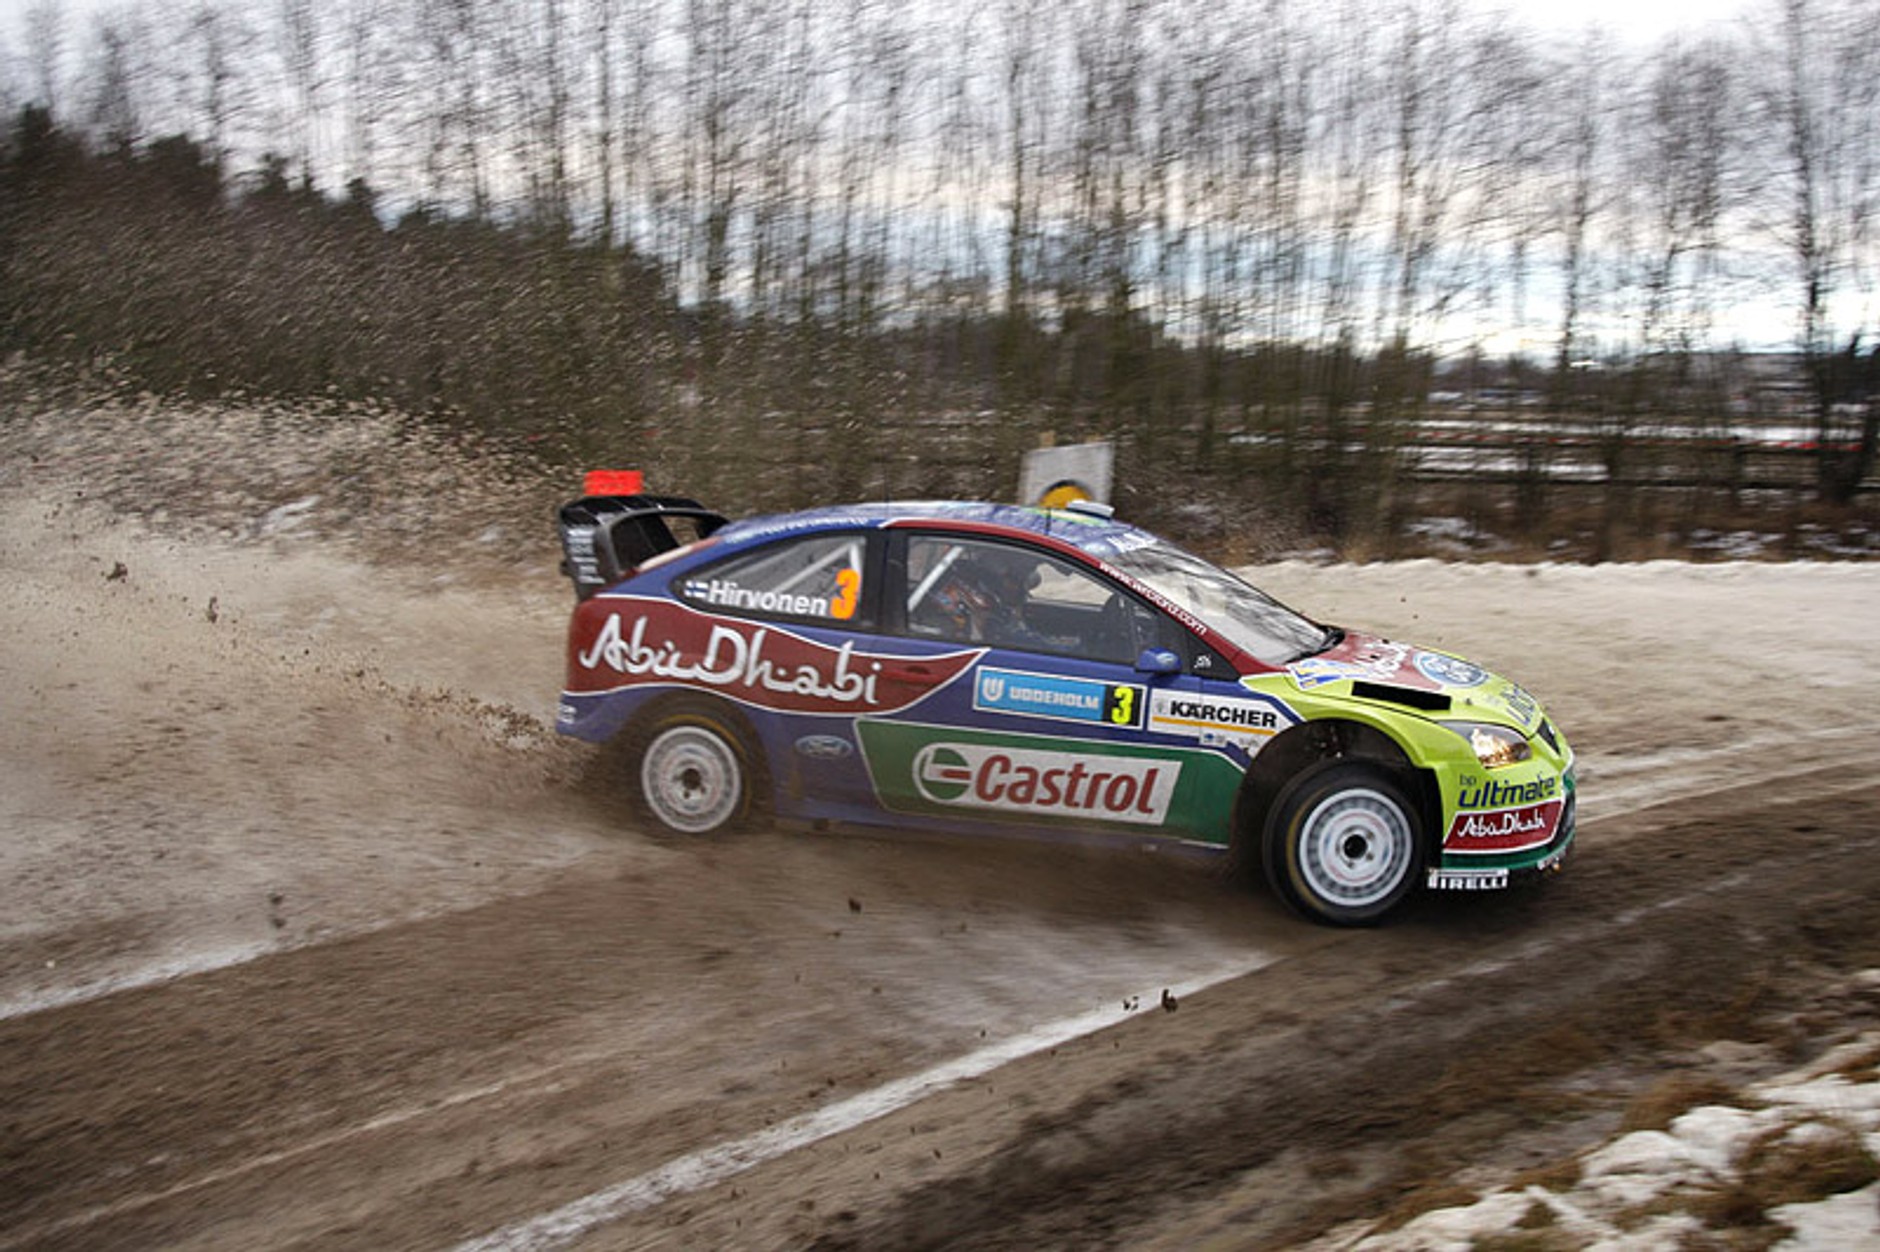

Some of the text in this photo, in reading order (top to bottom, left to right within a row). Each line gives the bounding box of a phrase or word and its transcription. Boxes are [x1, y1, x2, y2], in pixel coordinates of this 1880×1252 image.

[710, 580, 827, 616] Hirvonen
[830, 568, 861, 620] 3
[578, 612, 881, 704] Abu Dhabi
[1009, 685, 1099, 711] UDDEHOLM
[1111, 686, 1133, 724] 3
[1170, 700, 1277, 728] KÄRCHER
[975, 755, 1159, 814] Castrol
[1459, 773, 1555, 808] ultimate
[1428, 868, 1509, 889] PIRELLI
